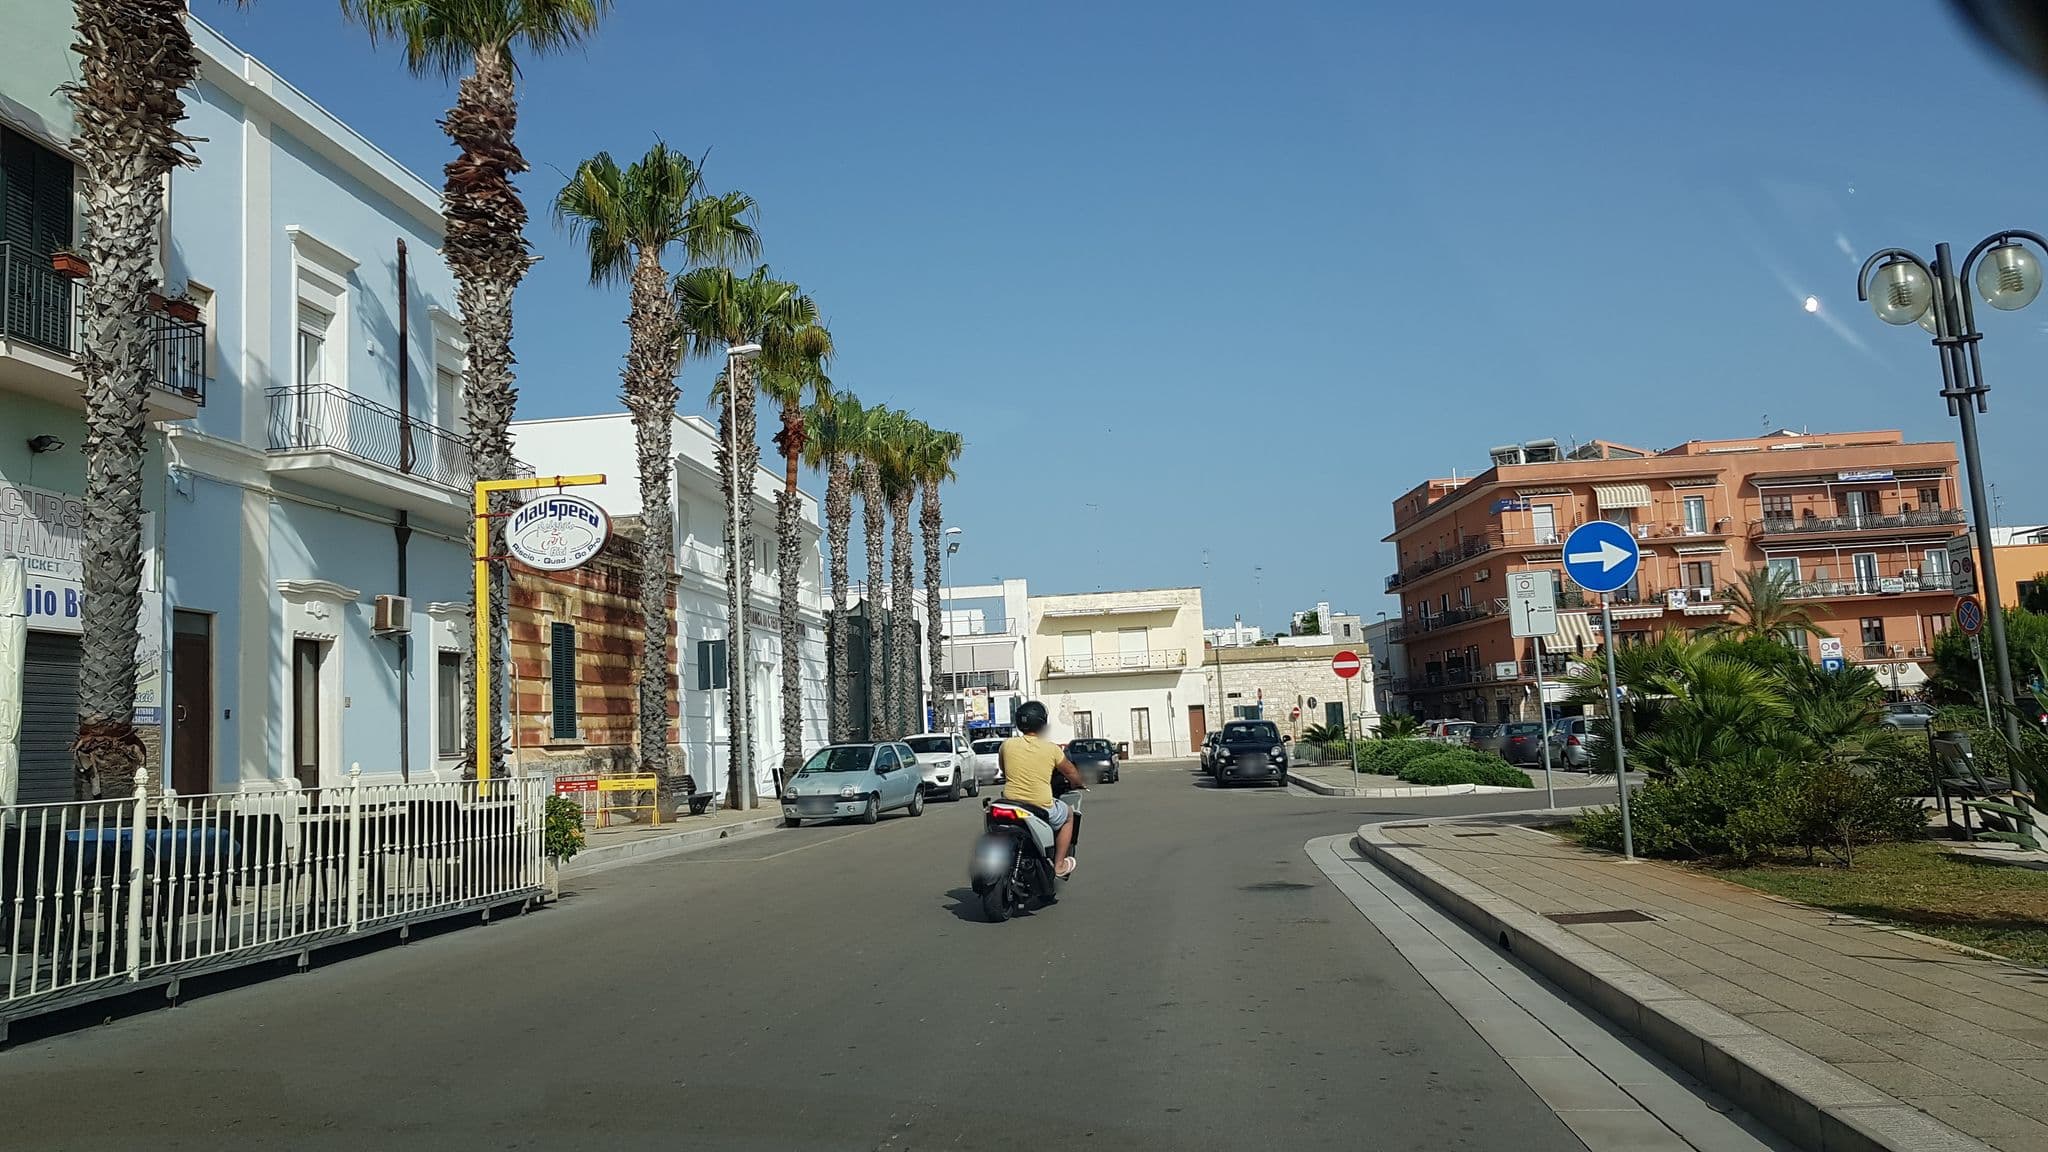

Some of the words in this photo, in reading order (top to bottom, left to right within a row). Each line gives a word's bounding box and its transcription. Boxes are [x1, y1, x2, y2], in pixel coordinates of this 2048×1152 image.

[0, 486, 84, 528] CURS
[0, 513, 84, 562] TAMA
[543, 557, 566, 565] Quad
[574, 551, 587, 560] Go
[587, 537, 601, 553] Pro
[19, 556, 61, 572] TICKET
